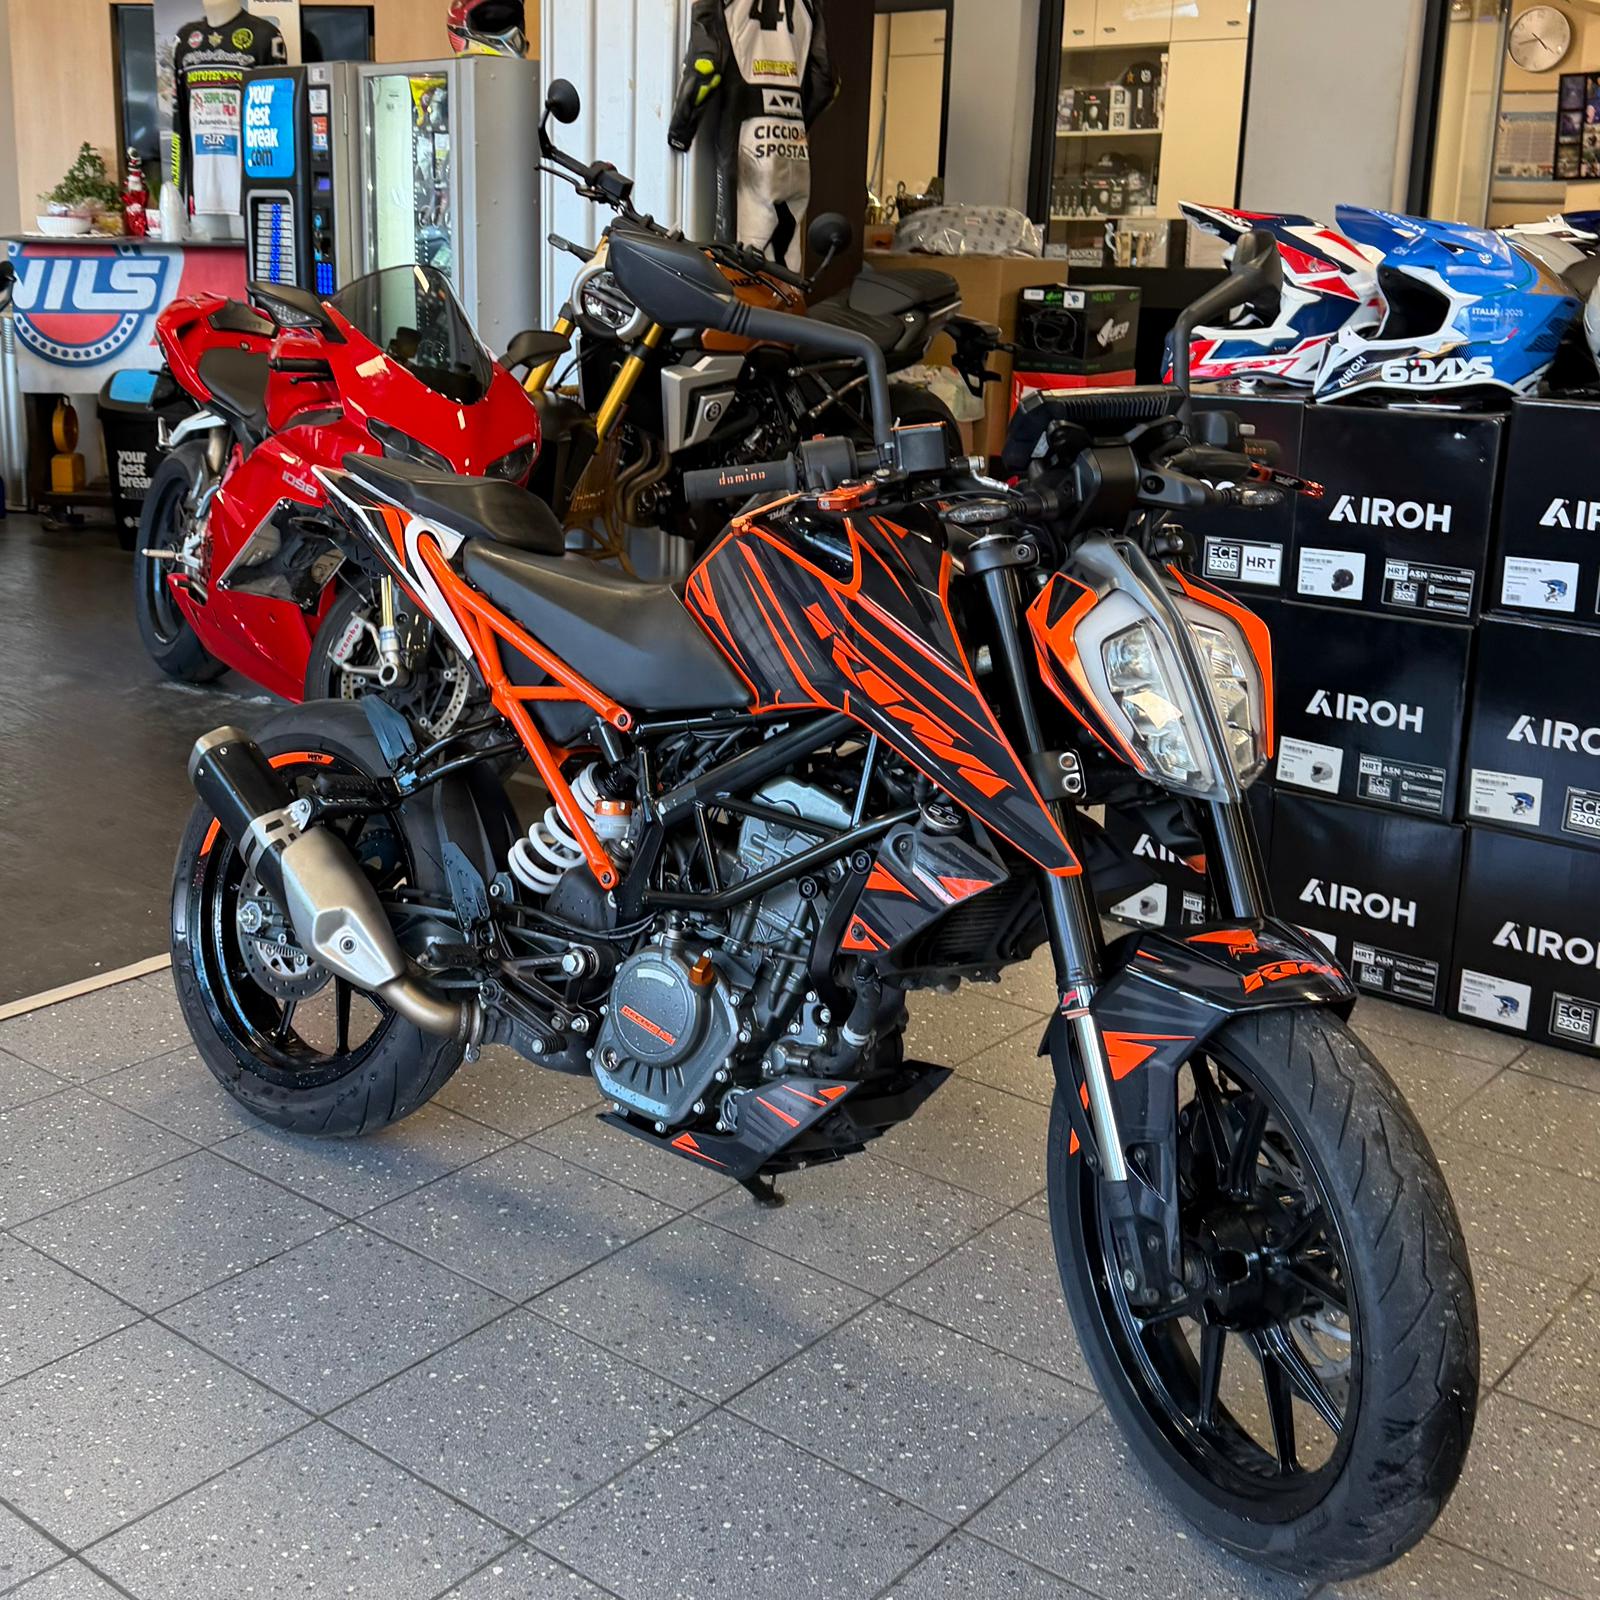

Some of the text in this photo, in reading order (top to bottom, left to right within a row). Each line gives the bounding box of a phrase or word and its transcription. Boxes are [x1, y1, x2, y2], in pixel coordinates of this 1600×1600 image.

[248, 85, 275, 104] your
[246, 102, 270, 126] best
[247, 126, 279, 148] break
[754, 125, 799, 140] CICCIO
[755, 143, 809, 158] SPOSTA
[117, 449, 147, 464] your
[118, 460, 147, 477] best
[1328, 494, 1452, 533] AIROH
[1210, 545, 1239, 560] ECE
[1210, 559, 1236, 570] 2206
[1246, 555, 1277, 570] HRT
[1394, 581, 1418, 592] ECE
[336, 622, 361, 660] brembo
[1304, 689, 1424, 734] AIROH
[1299, 878, 1417, 928] AIROH
[1492, 920, 1600, 970] AIRO
[1559, 1003, 1593, 1023] ECE
[1558, 1017, 1590, 1034] 2206
